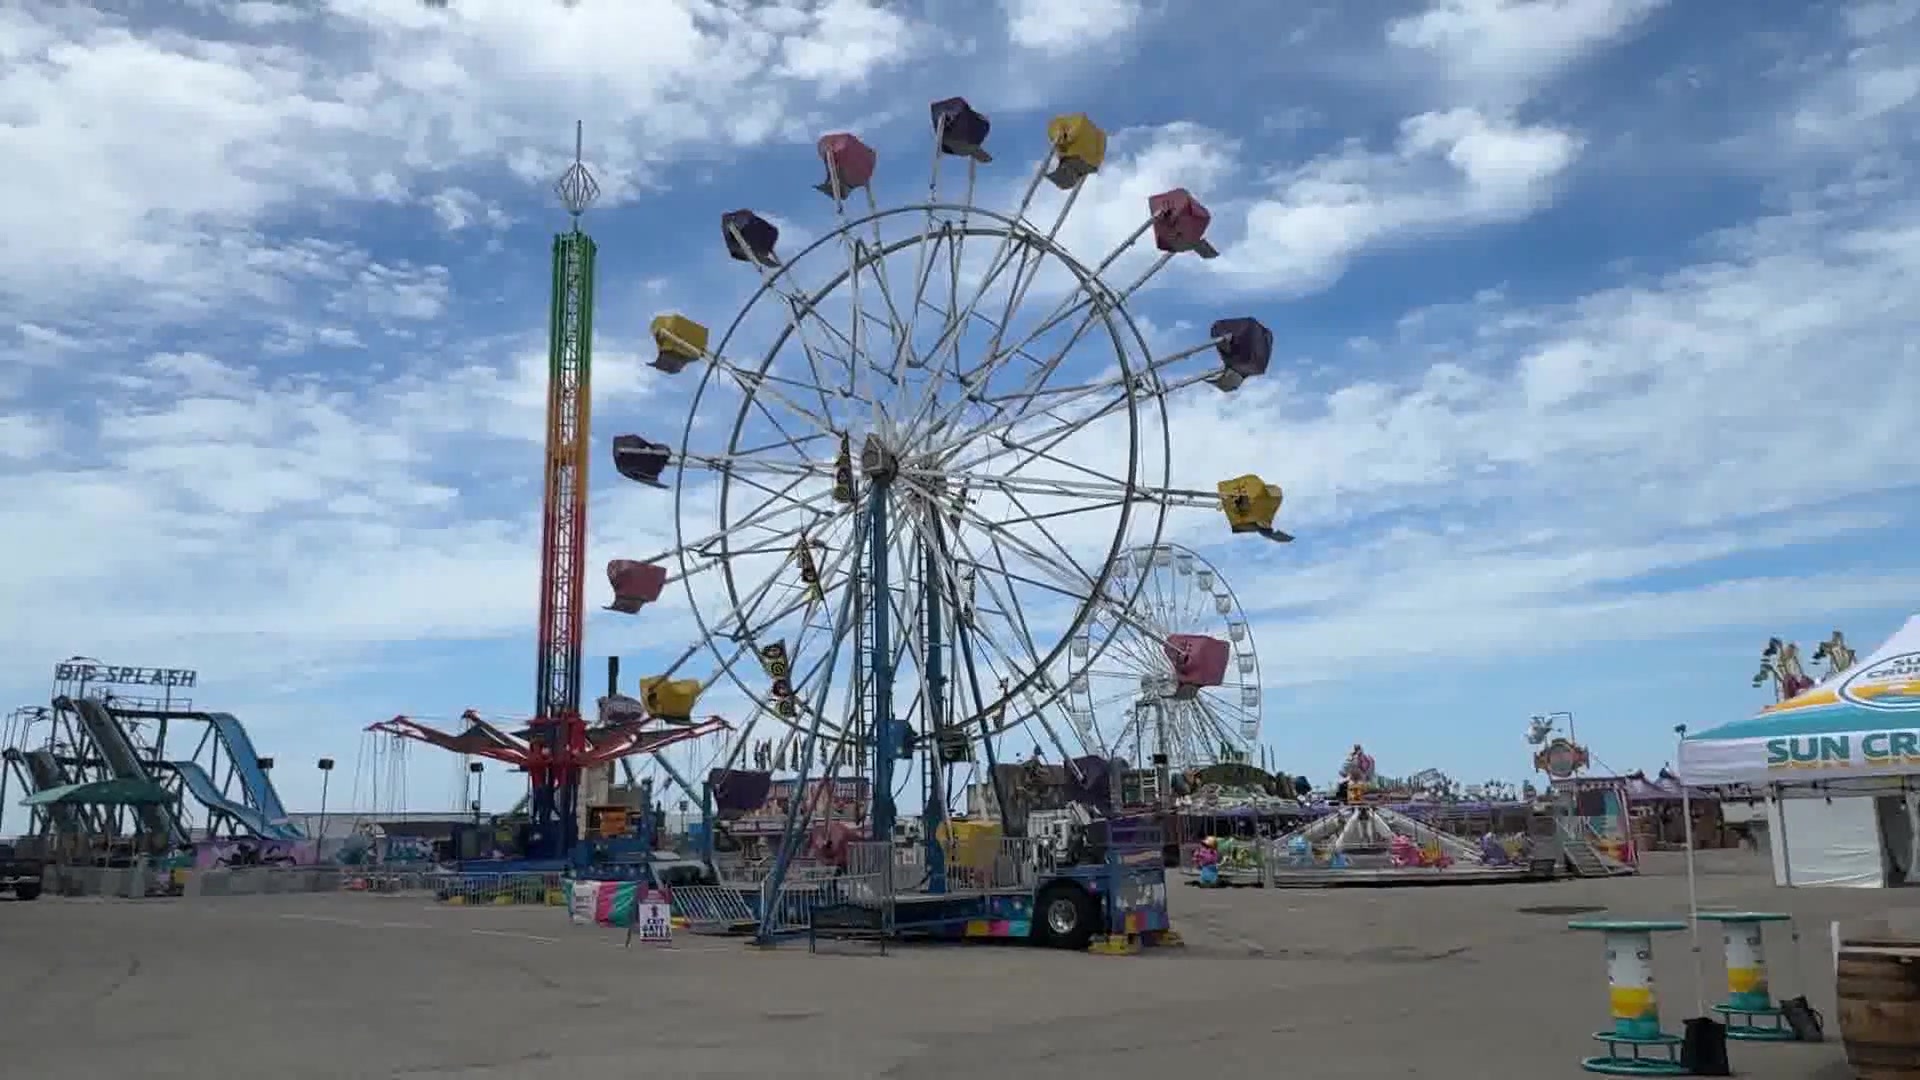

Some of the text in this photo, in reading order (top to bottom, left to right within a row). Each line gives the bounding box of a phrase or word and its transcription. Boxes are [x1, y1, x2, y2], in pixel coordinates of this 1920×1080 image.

[55, 663, 196, 687] BIG SPLASH
[1767, 735, 1850, 764] SUN
